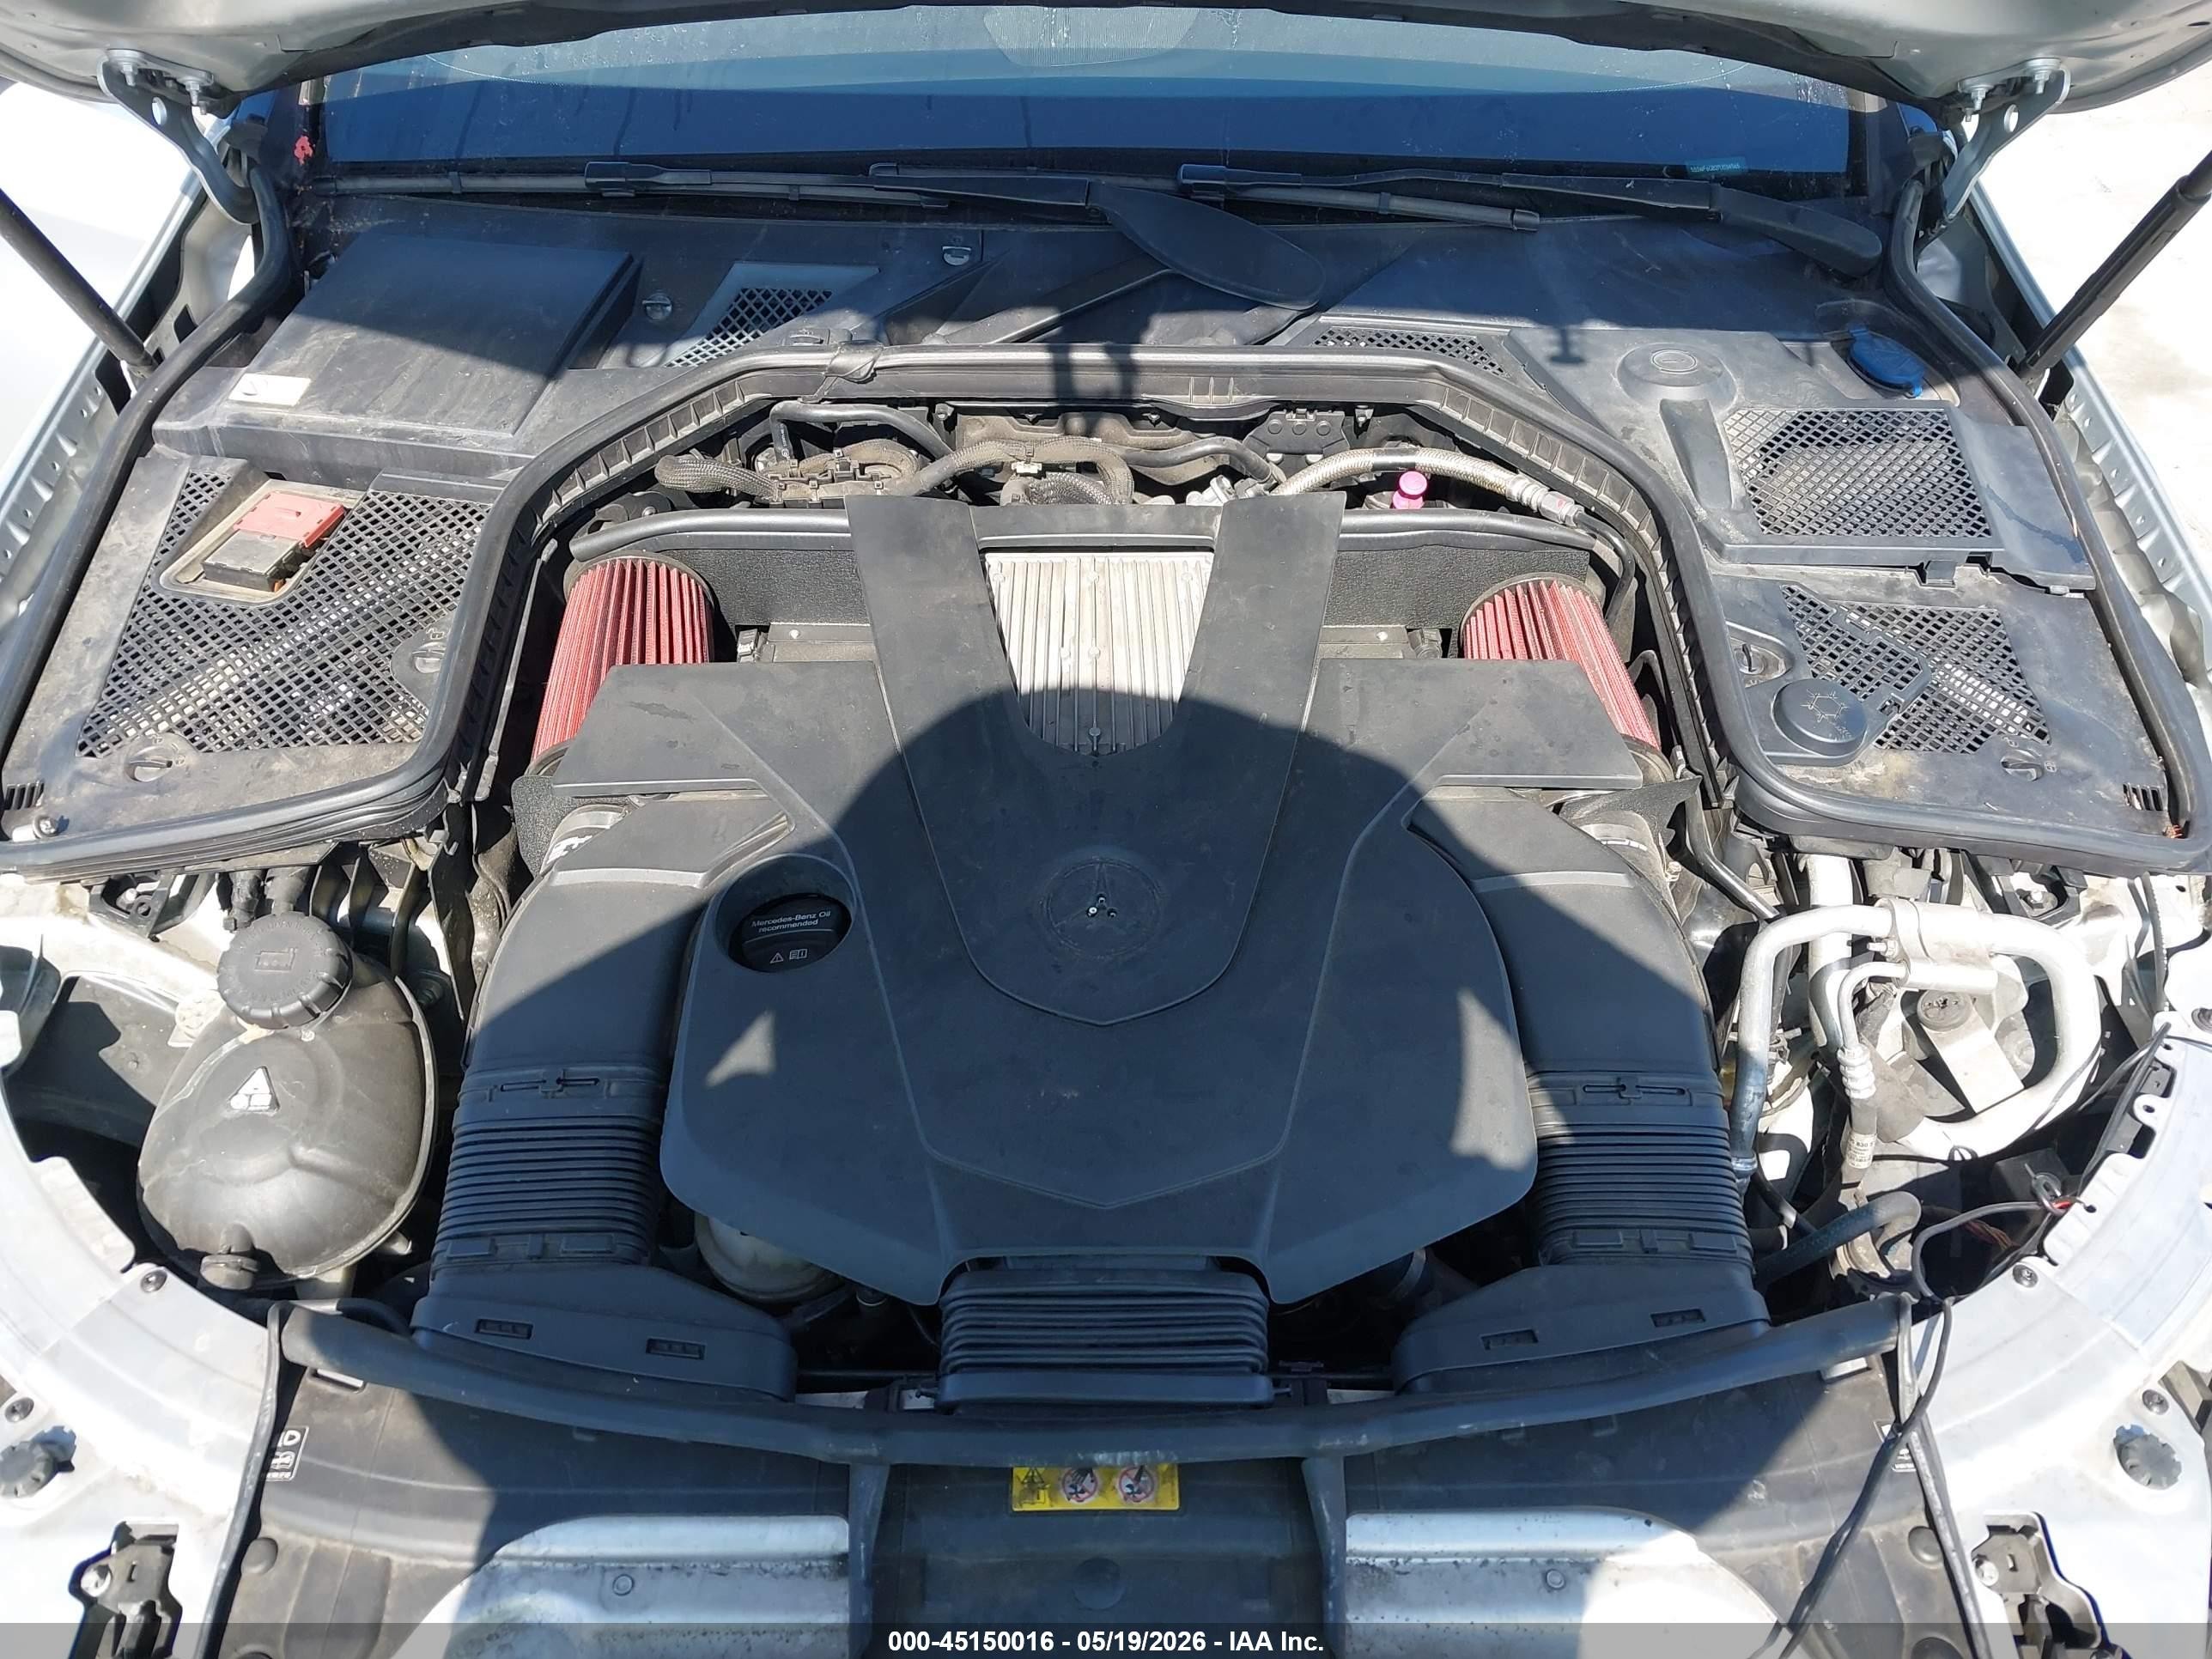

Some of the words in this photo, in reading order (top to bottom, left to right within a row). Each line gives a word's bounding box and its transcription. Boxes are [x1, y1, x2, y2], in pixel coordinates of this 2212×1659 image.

[751, 914, 817, 927] Mercedes-Benz
[818, 910, 830, 919] Oil
[758, 919, 818, 933] recommended
